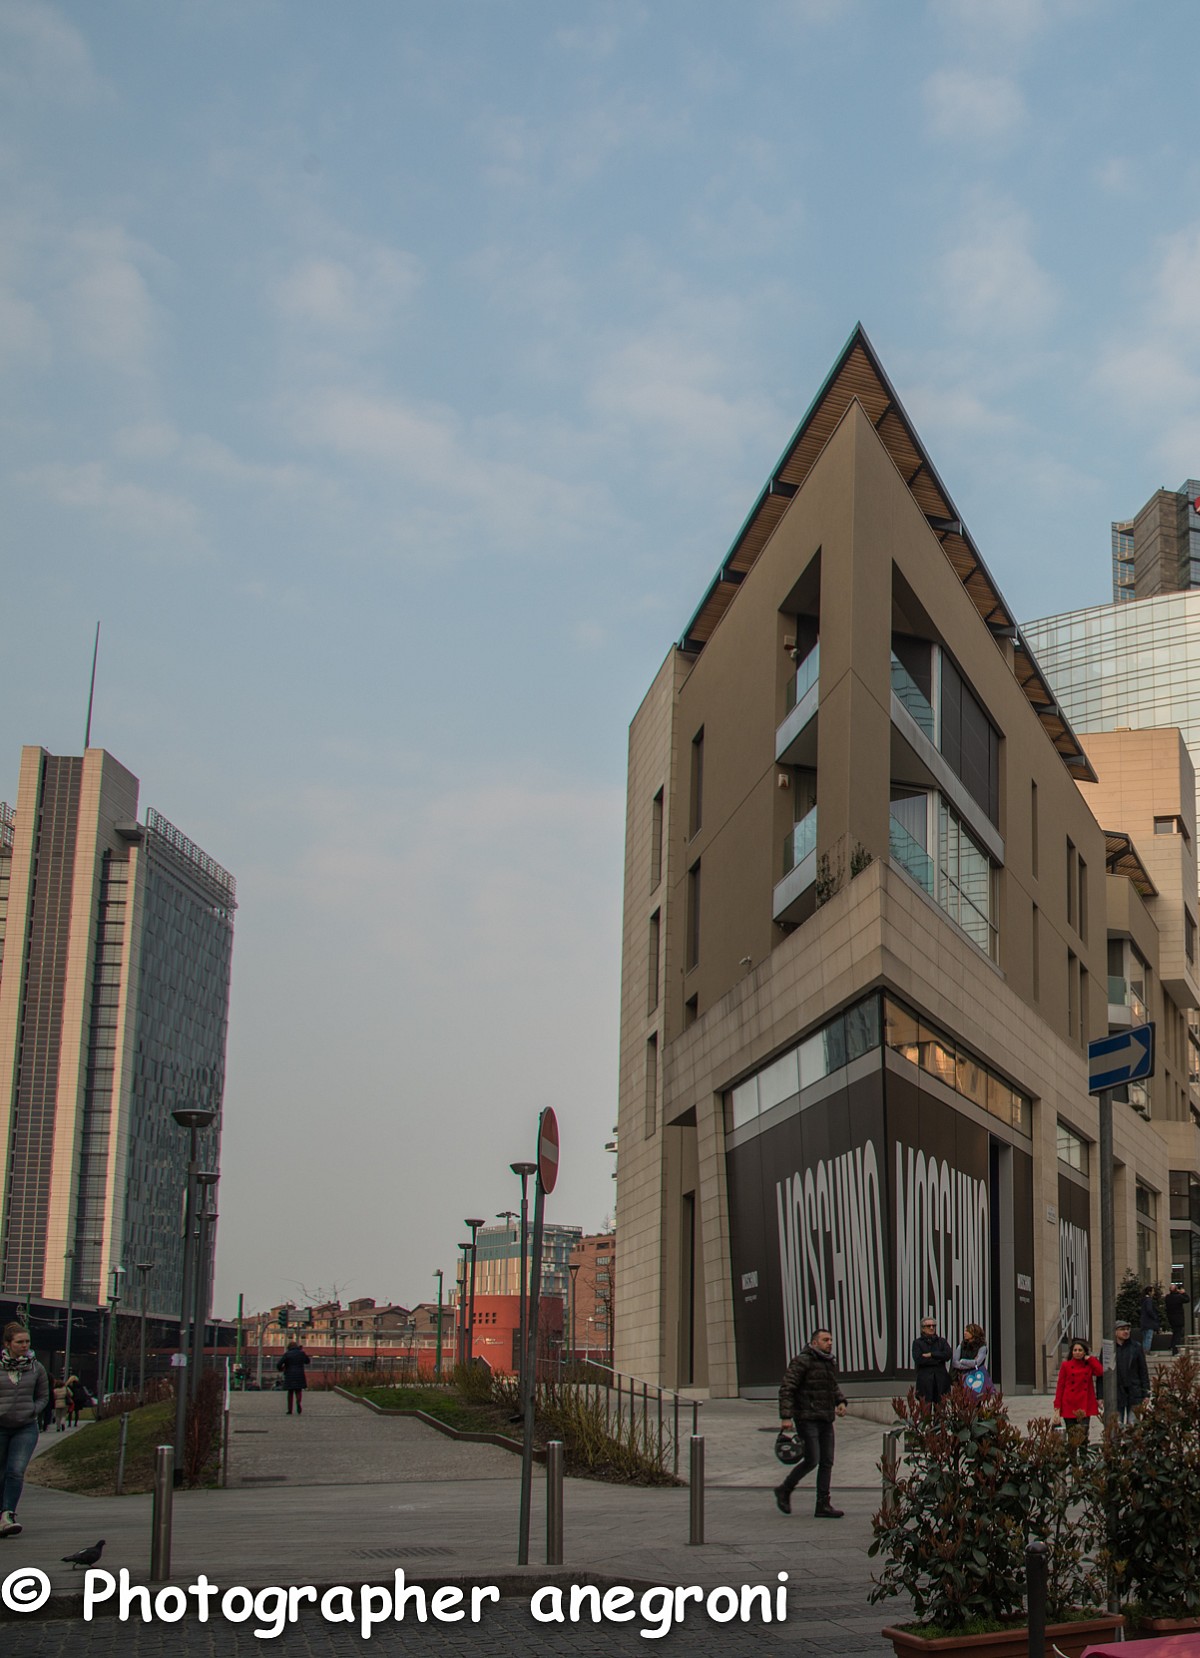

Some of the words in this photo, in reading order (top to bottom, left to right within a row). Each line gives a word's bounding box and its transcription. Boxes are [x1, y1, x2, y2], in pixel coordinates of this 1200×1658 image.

[776, 1139, 888, 1374] MOSCHINO
[896, 1140, 989, 1371] MOSCHINO
[1059, 1217, 1089, 1342] OSCHINO
